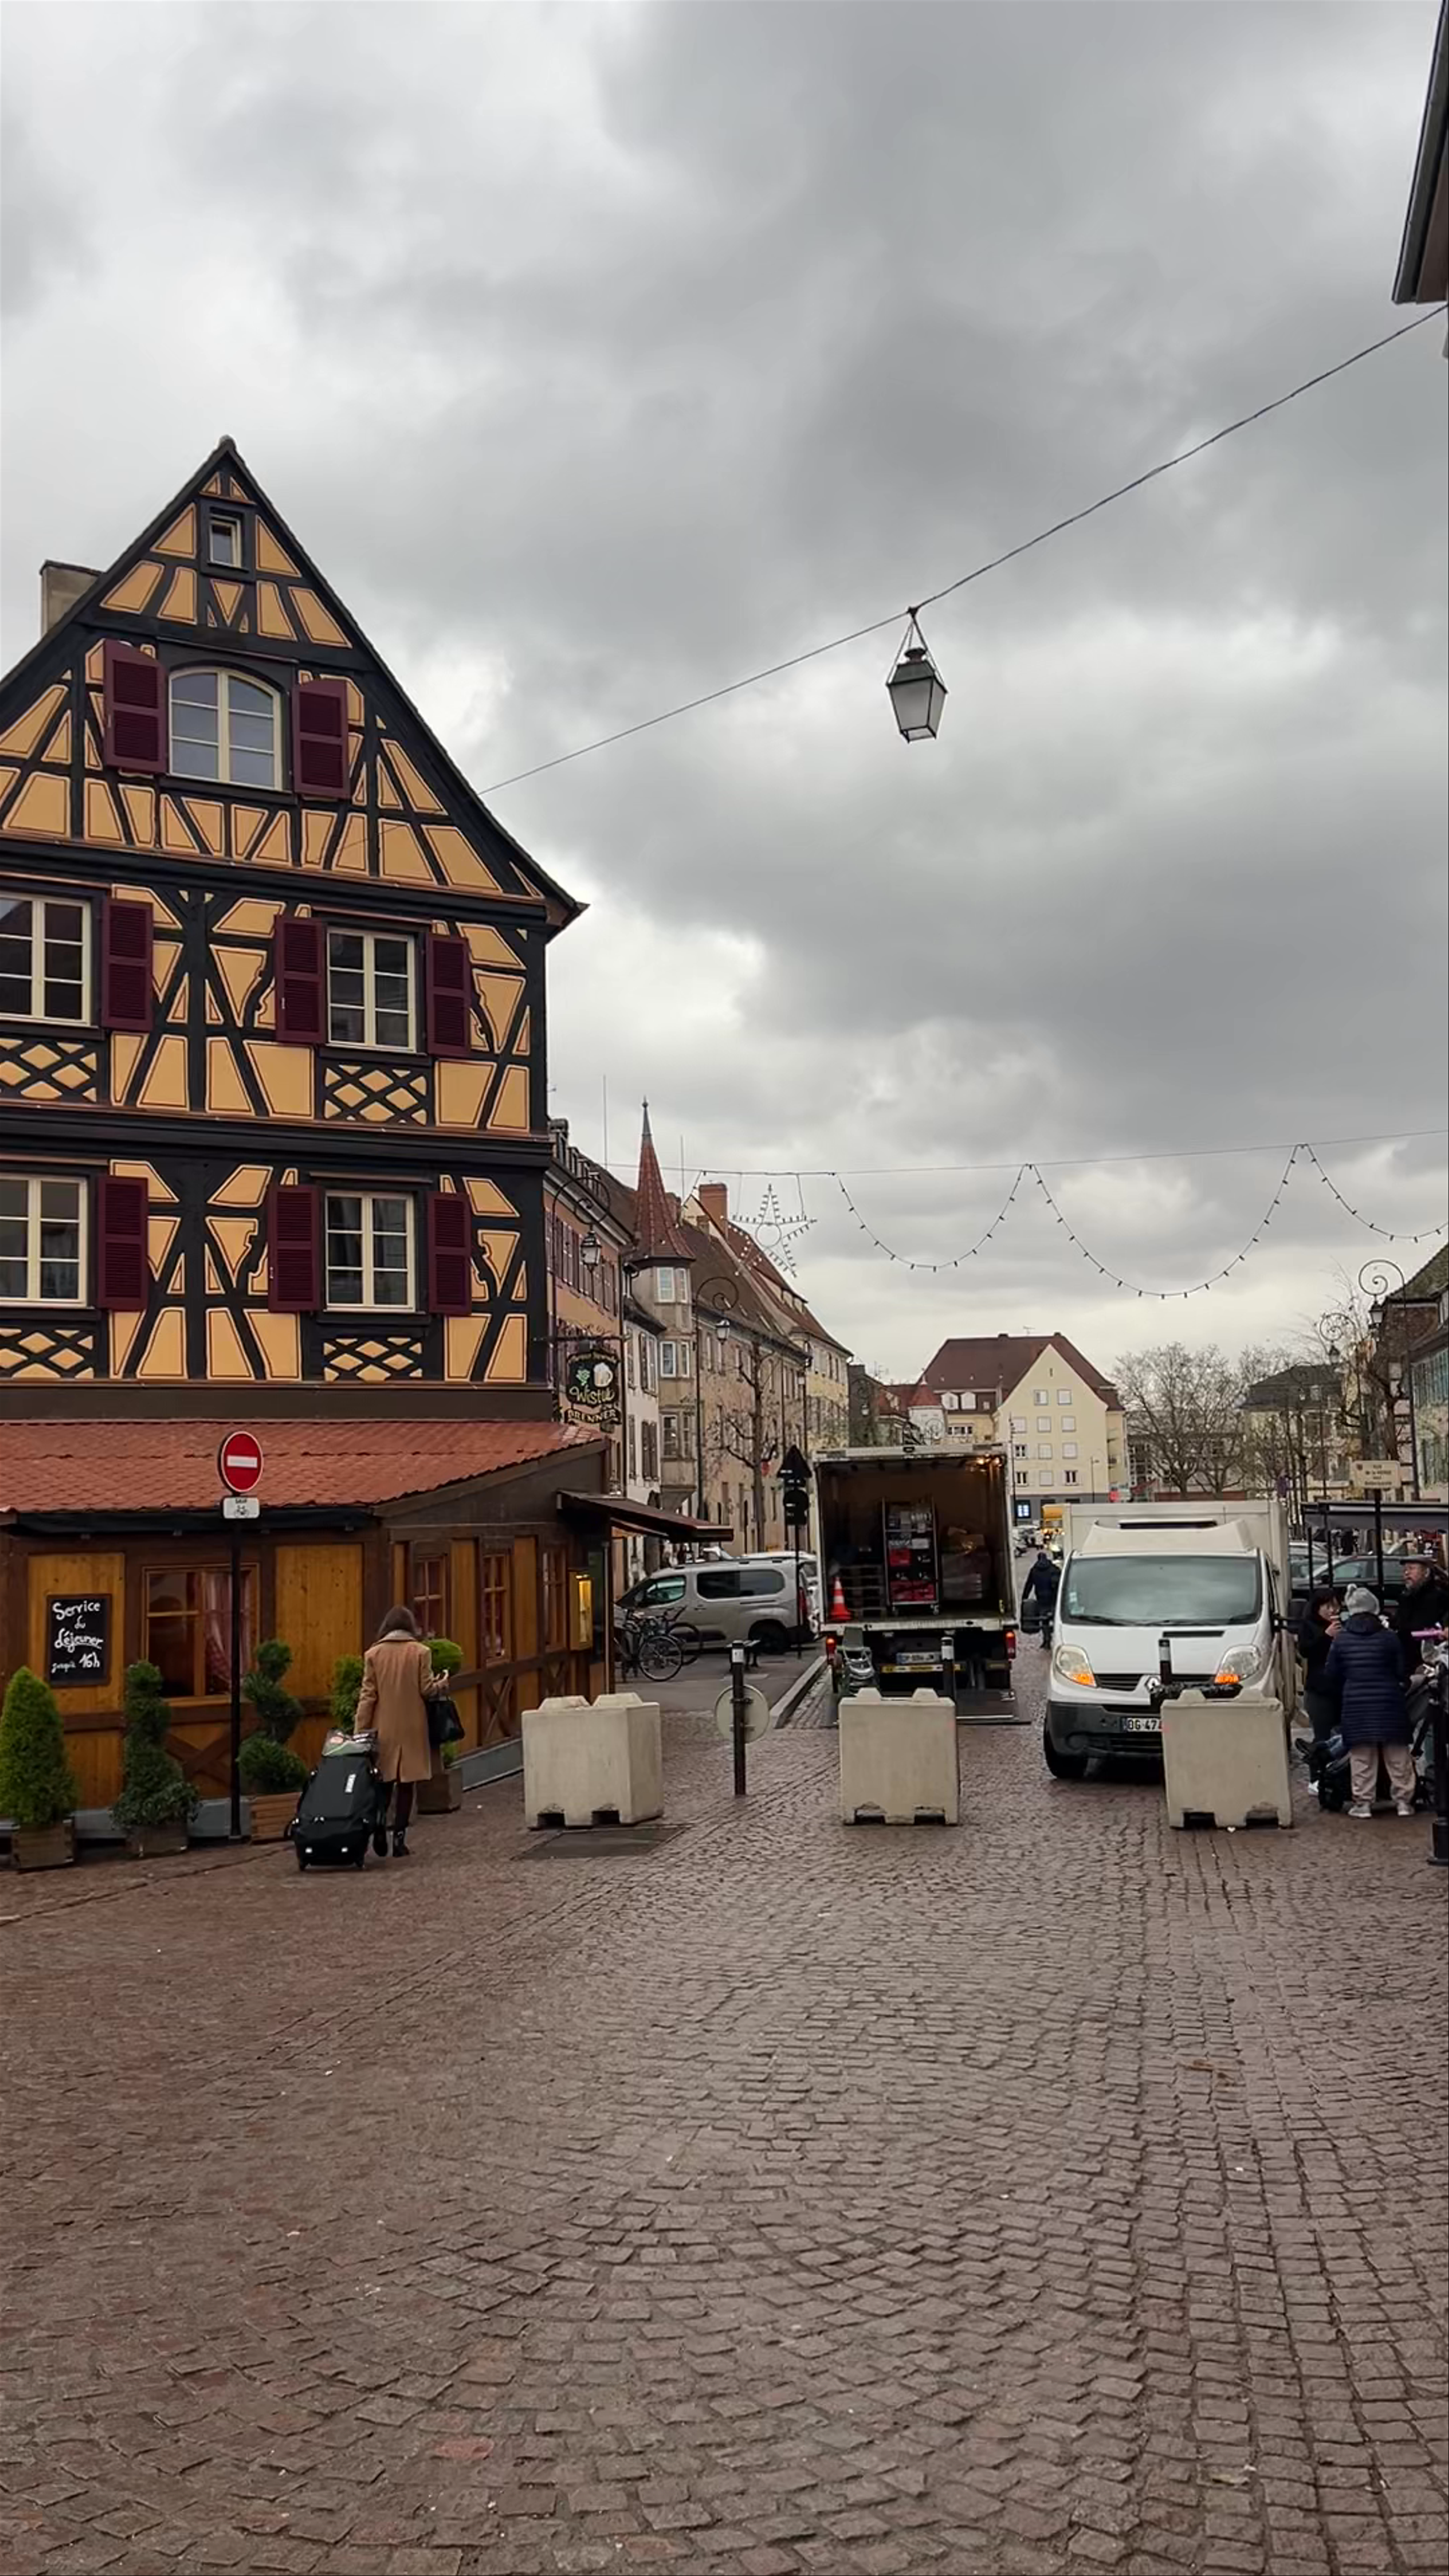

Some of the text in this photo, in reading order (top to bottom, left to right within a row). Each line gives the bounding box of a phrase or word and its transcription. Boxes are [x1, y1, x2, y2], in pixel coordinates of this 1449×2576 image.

[568, 1409, 616, 1423] BRENNER
[52, 1600, 100, 1620] Service
[78, 1651, 100, 1668] 16h
